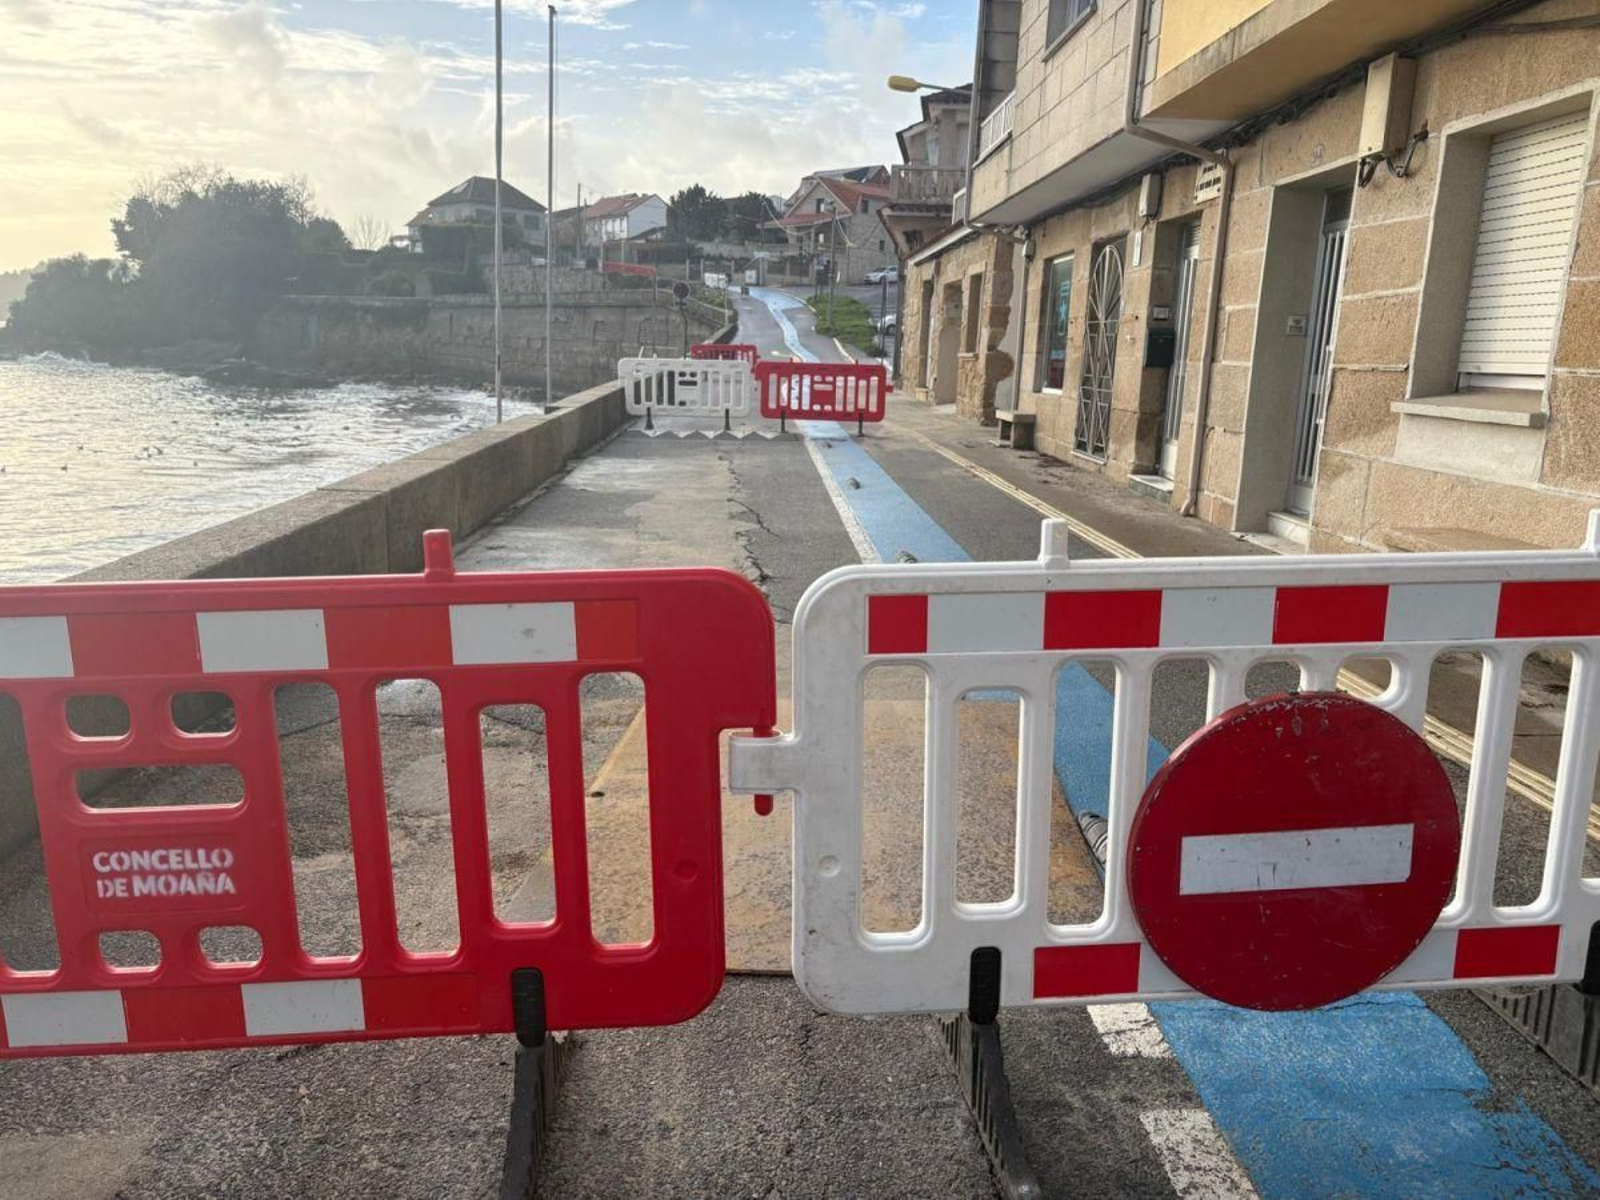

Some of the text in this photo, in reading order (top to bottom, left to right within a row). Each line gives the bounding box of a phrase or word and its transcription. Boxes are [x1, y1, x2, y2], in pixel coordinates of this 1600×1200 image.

[93, 848, 234, 872] CONCELLO
[96, 871, 236, 898] DE MOAÑA
